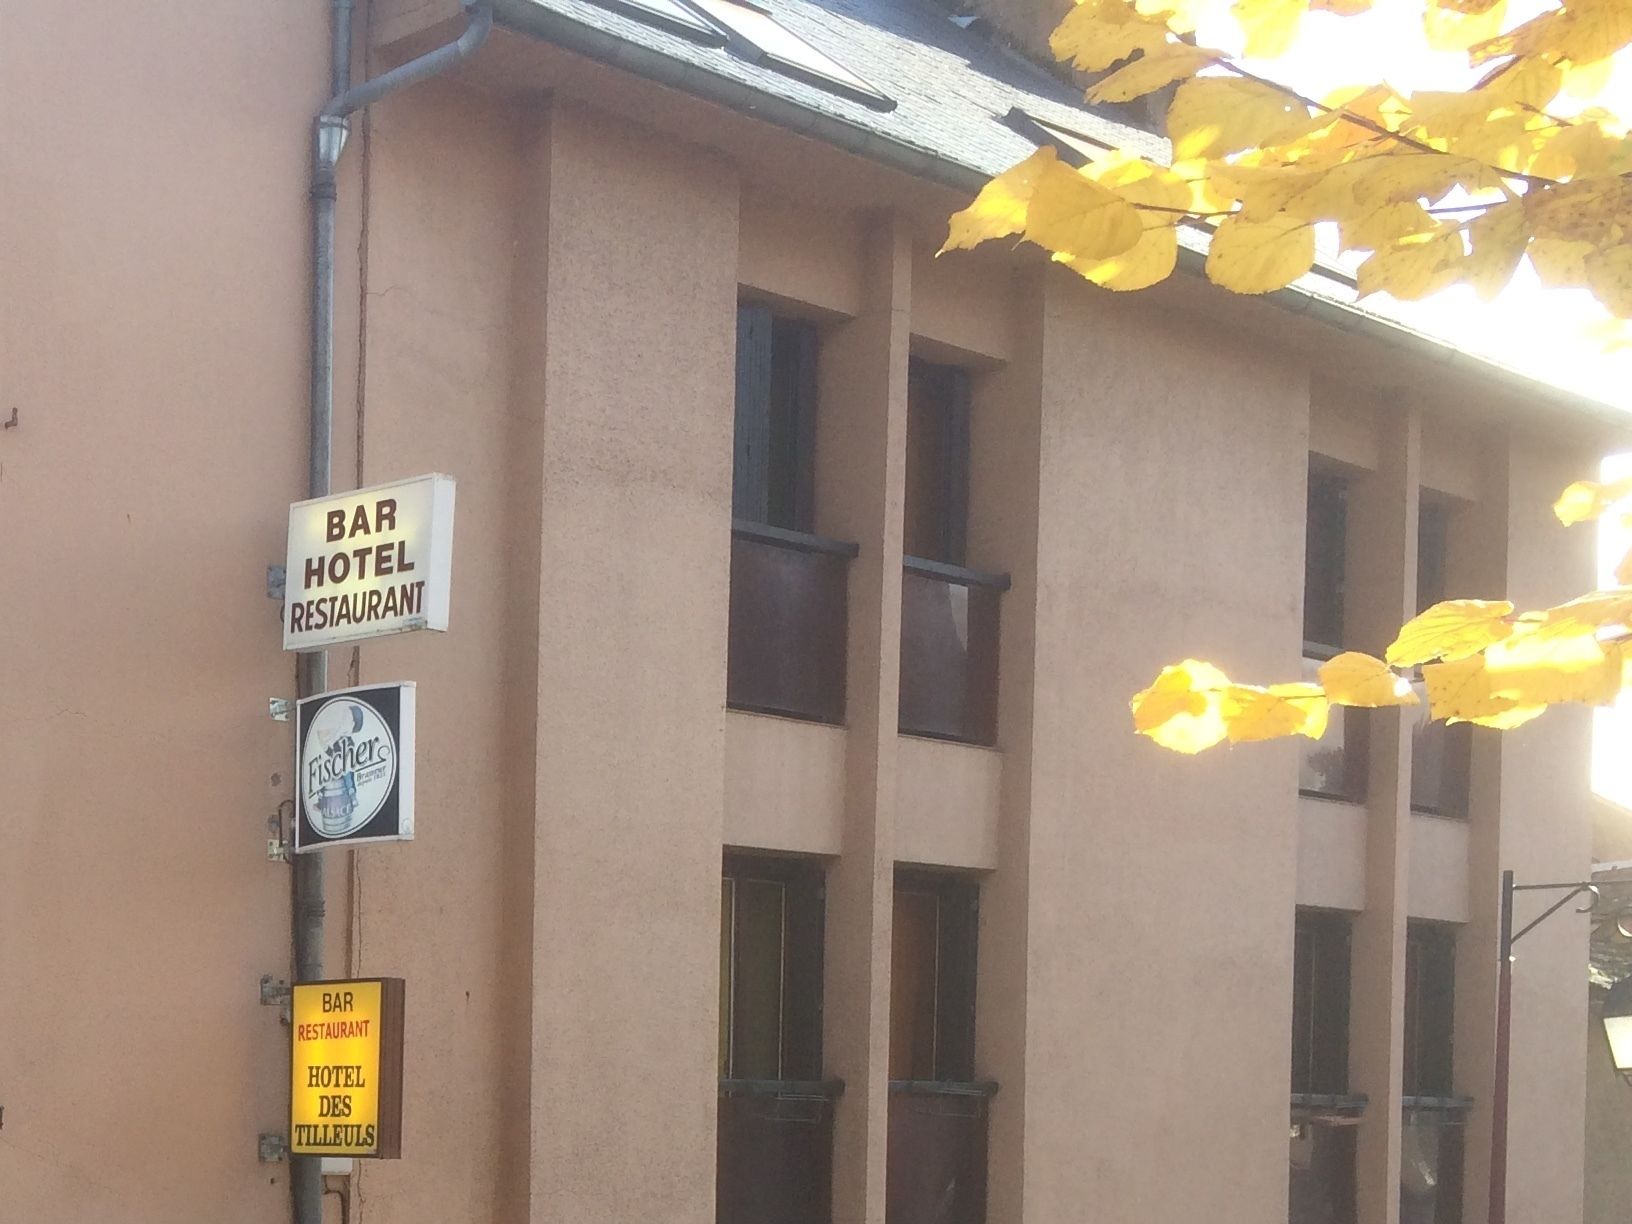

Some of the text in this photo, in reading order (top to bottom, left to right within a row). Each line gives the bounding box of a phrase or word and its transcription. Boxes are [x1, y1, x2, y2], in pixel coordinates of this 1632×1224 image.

[326, 498, 397, 543] BAR
[304, 540, 415, 590] HOTEL
[290, 580, 425, 634] RESTAURANT
[308, 736, 379, 795] Fischer
[322, 991, 354, 1013] BAR
[298, 1020, 370, 1041] RESTAURANT
[307, 1065, 366, 1088] HOTEL
[318, 1095, 352, 1118] DES
[295, 1124, 375, 1147] TILLEULS
